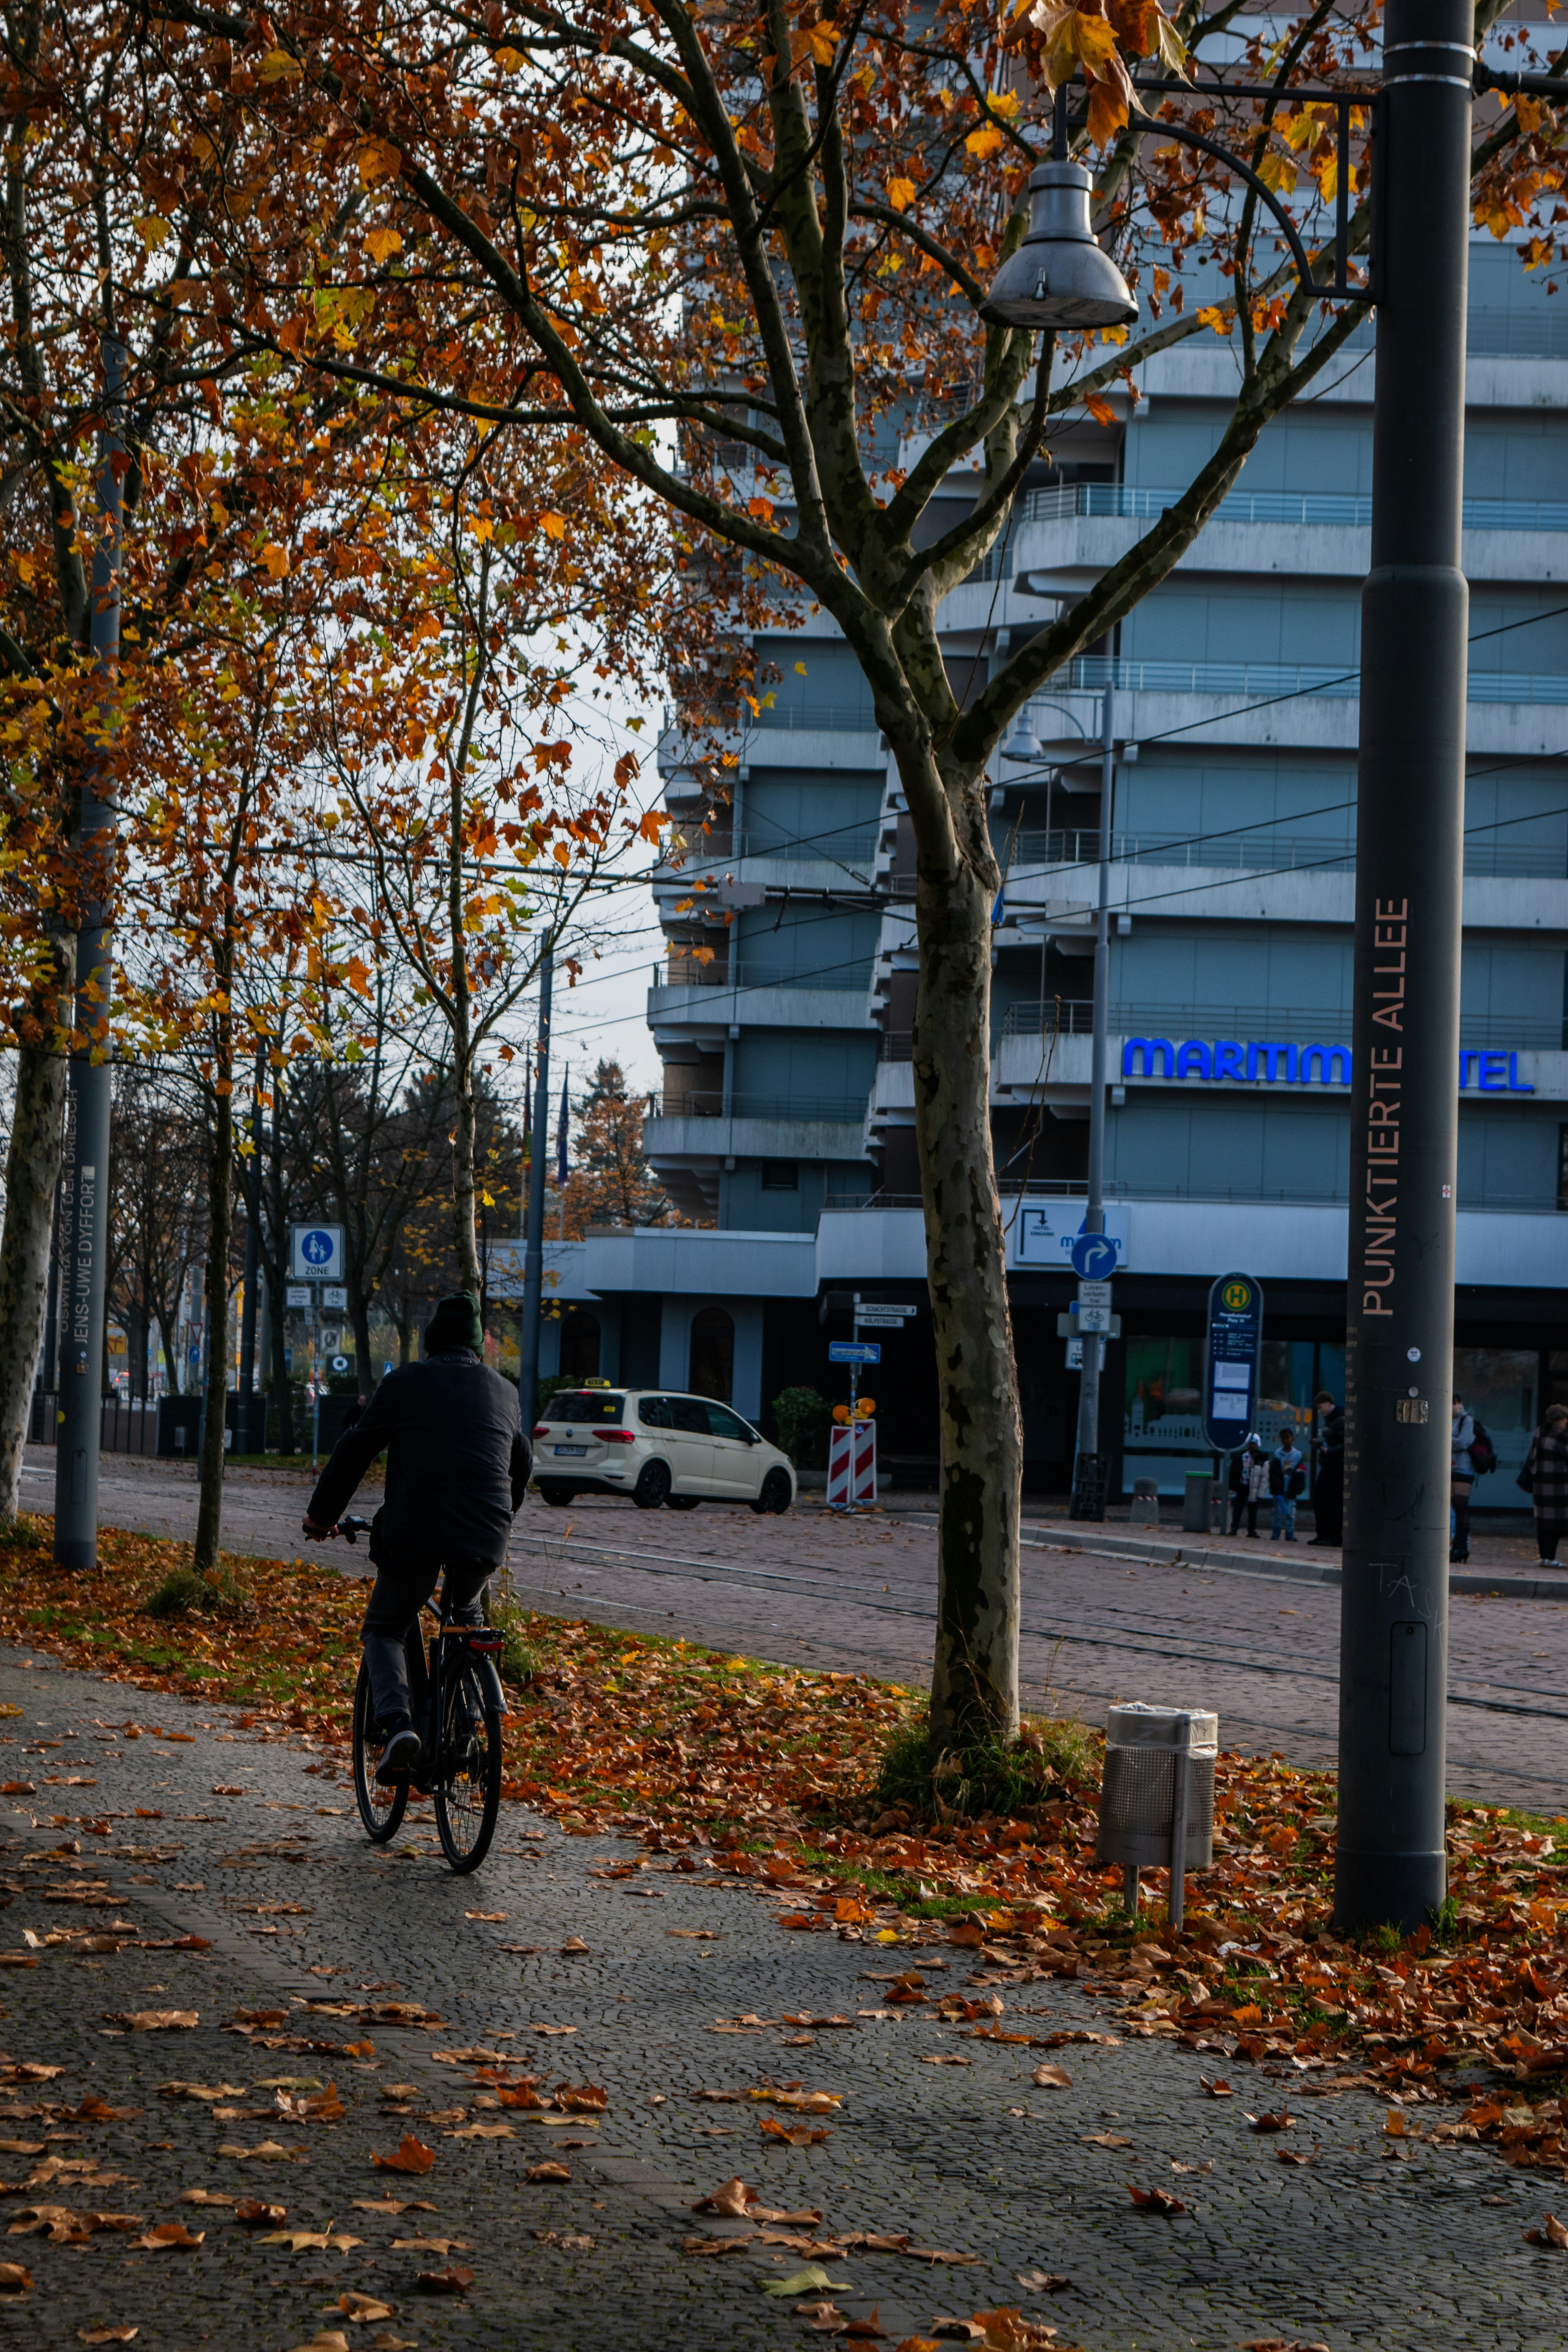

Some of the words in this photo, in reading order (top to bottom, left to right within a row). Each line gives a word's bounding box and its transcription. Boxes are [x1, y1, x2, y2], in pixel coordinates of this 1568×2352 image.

[1372, 897, 1408, 1031] ALLEE
[1459, 1050, 1534, 1092] TEL
[64, 1168, 75, 1205] DEN
[1363, 1046, 1403, 1316] PUNKTIERTE
[62, 1210, 73, 1247] VON
[305, 1266, 329, 1274] ZONE
[74, 1257, 92, 1344] JENS-UWE
[1230, 1288, 1243, 1303] H
